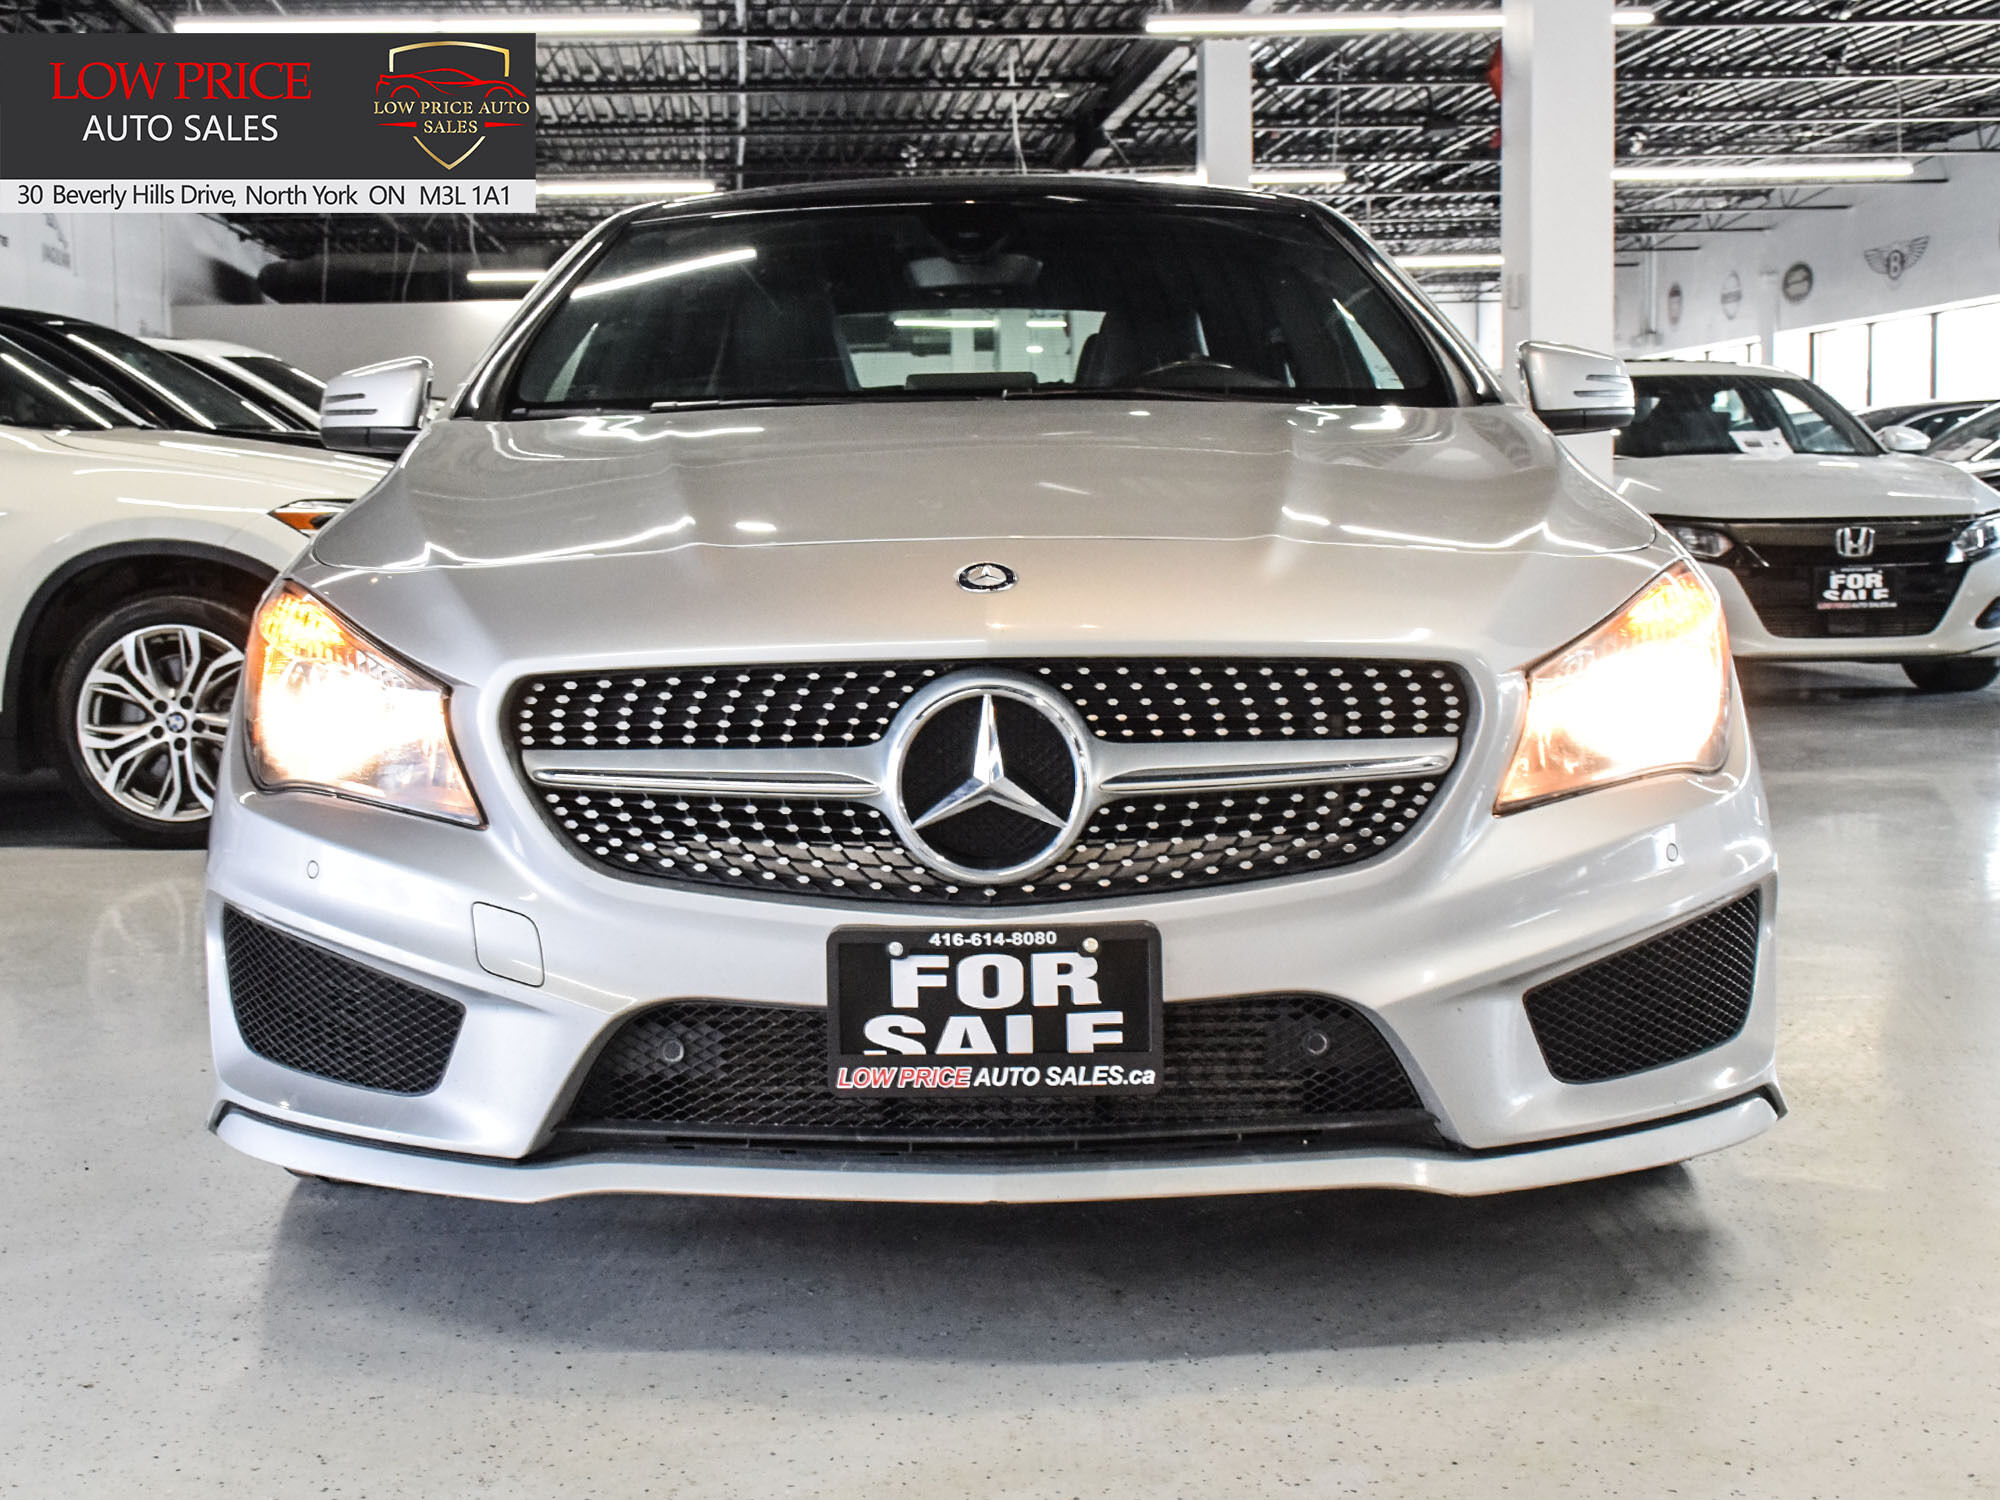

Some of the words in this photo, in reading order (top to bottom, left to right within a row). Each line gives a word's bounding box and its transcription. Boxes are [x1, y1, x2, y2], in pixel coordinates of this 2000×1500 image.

[1829, 573, 1884, 589] FOR
[929, 931, 1057, 947] 416-614-8080
[891, 952, 1102, 1010] FOR
[837, 1067, 897, 1089] LOW
[897, 1067, 972, 1089] PRICE
[974, 1067, 1041, 1088] AUTO
[1044, 1065, 1156, 1087] SALES.ca
